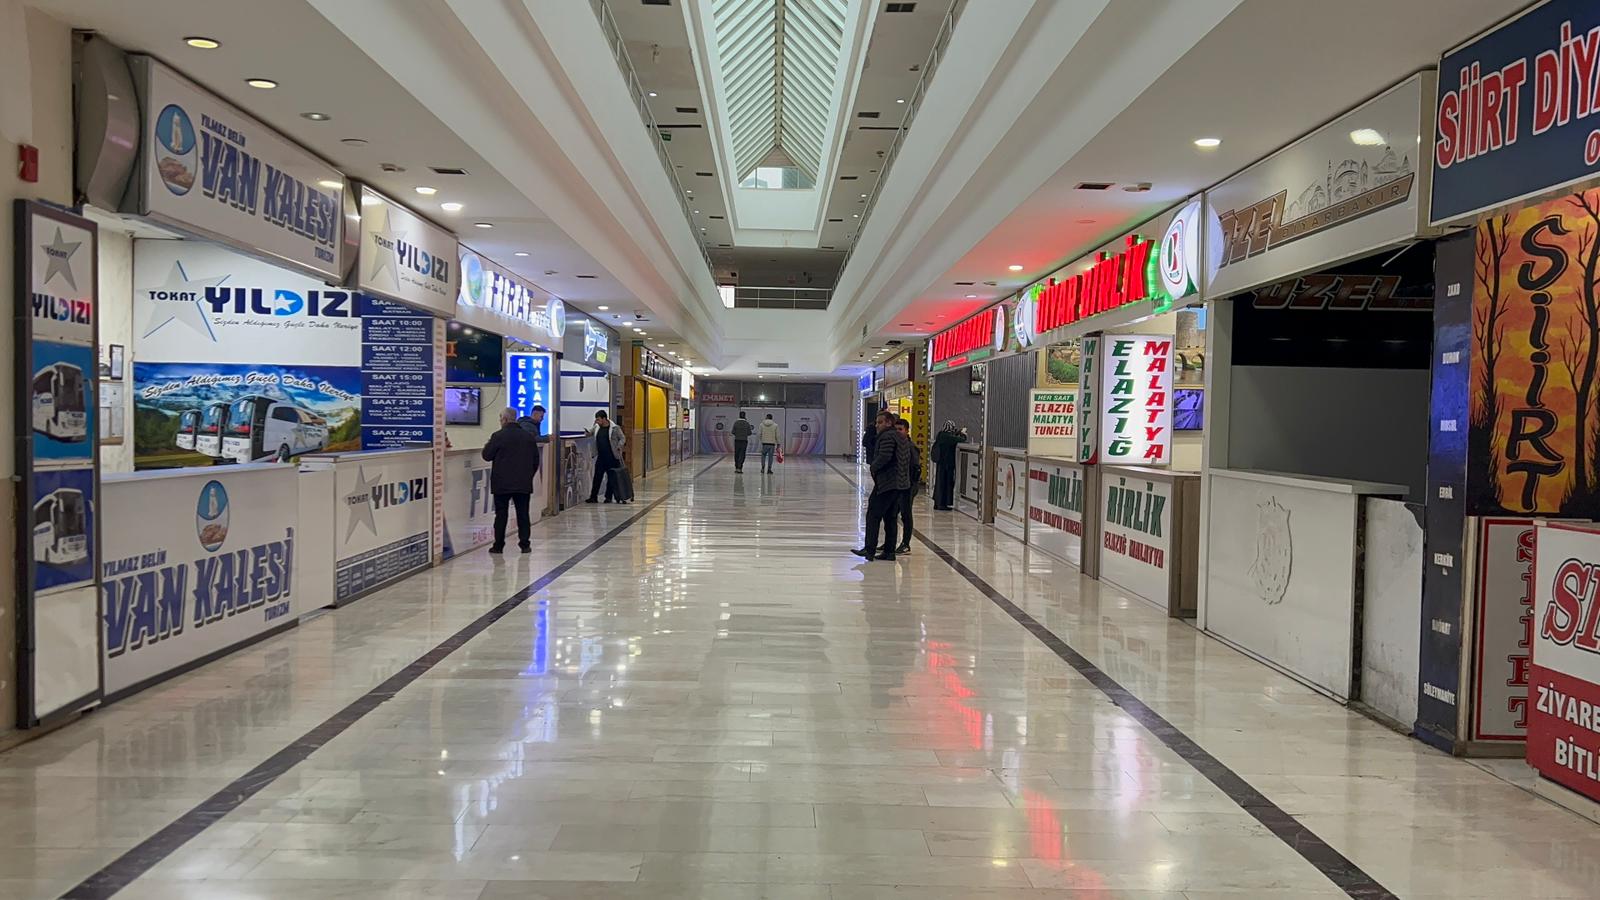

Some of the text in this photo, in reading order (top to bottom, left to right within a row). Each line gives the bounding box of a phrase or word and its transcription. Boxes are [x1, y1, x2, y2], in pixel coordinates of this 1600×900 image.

[1437, 61, 1527, 169] SİİRT
[200, 130, 339, 248] VAN KALESİ
[397, 239, 449, 284] YILDIZI
[1080, 235, 1155, 318] BİRLİK
[32, 292, 91, 325] YILDIZI
[149, 287, 362, 318] TOKAT YILDIZI
[283, 375, 313, 389] Daha
[1081, 340, 1097, 460] MALATYA
[1107, 340, 1135, 457] ELAZIĞ
[1143, 341, 1171, 459] MALATYA
[1033, 415, 1074, 424] MALATYA
[1034, 402, 1074, 413] ELAZIĞ
[1034, 424, 1074, 436] TUNCELİ
[371, 477, 428, 510] YILDIZI
[1106, 477, 1166, 538] BİRLİK
[103, 548, 167, 578] YILMAZ BELİN
[1104, 530, 1165, 569] ELAZIĞ MALATYA
[102, 563, 188, 659] VAN
[193, 527, 294, 629] KALESİ
[264, 601, 290, 622] TURİZM
[1537, 682, 1600, 733] ZİYARE
